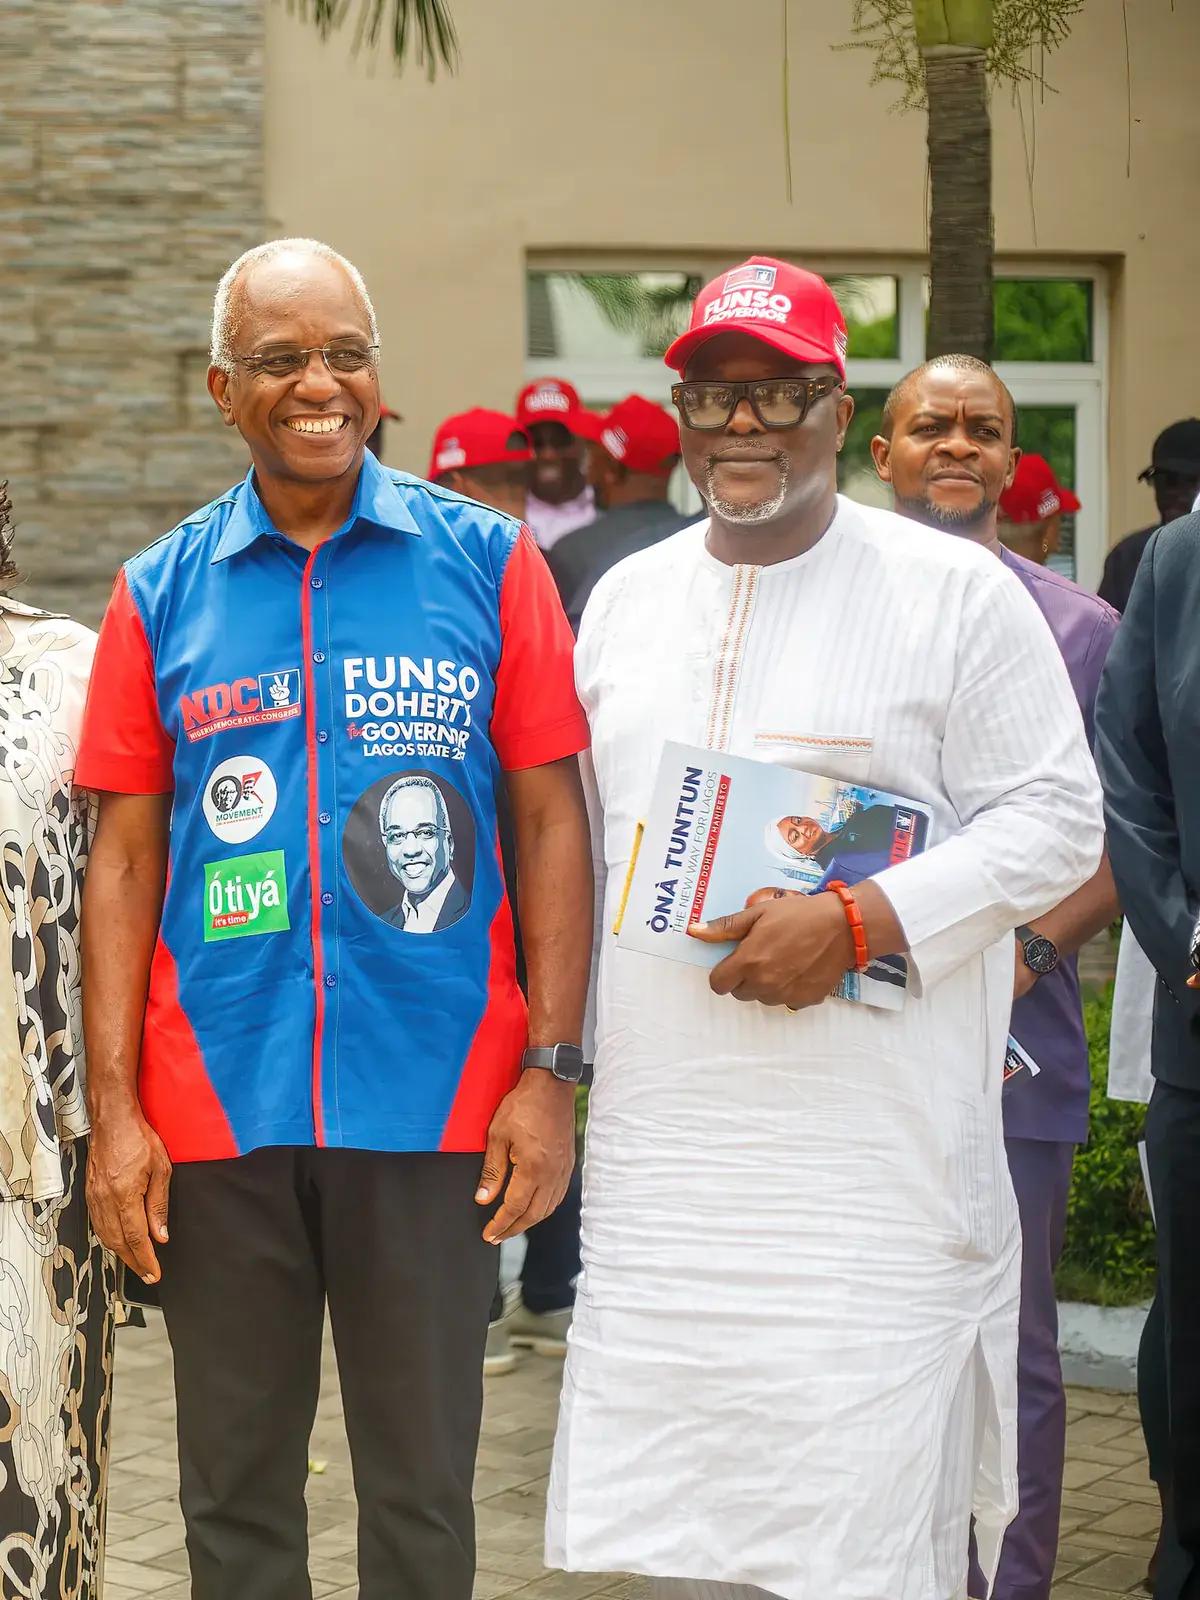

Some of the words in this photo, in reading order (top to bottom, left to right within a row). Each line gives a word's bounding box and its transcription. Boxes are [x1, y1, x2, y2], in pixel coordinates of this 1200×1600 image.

[704, 290, 792, 322] FUNSO
[343, 656, 480, 701] FUNSO
[180, 677, 260, 731] NDC
[345, 691, 471, 727] DOHERTY
[363, 743, 416, 757] LAGOS
[417, 743, 450, 758] STATE
[700, 771, 717, 814] LAGOS
[216, 806, 264, 822] MOVEMENT
[664, 766, 703, 869] TUNTUN
[711, 783, 728, 834] MANIFESTO
[694, 817, 707, 843] FOR
[686, 845, 701, 874] WAY
[701, 836, 715, 877] DOHERTY
[679, 877, 694, 907] NEW
[694, 880, 706, 910] FUNSO
[227, 915, 247, 925] time
[672, 910, 687, 933] THE
[690, 912, 700, 925] HE
